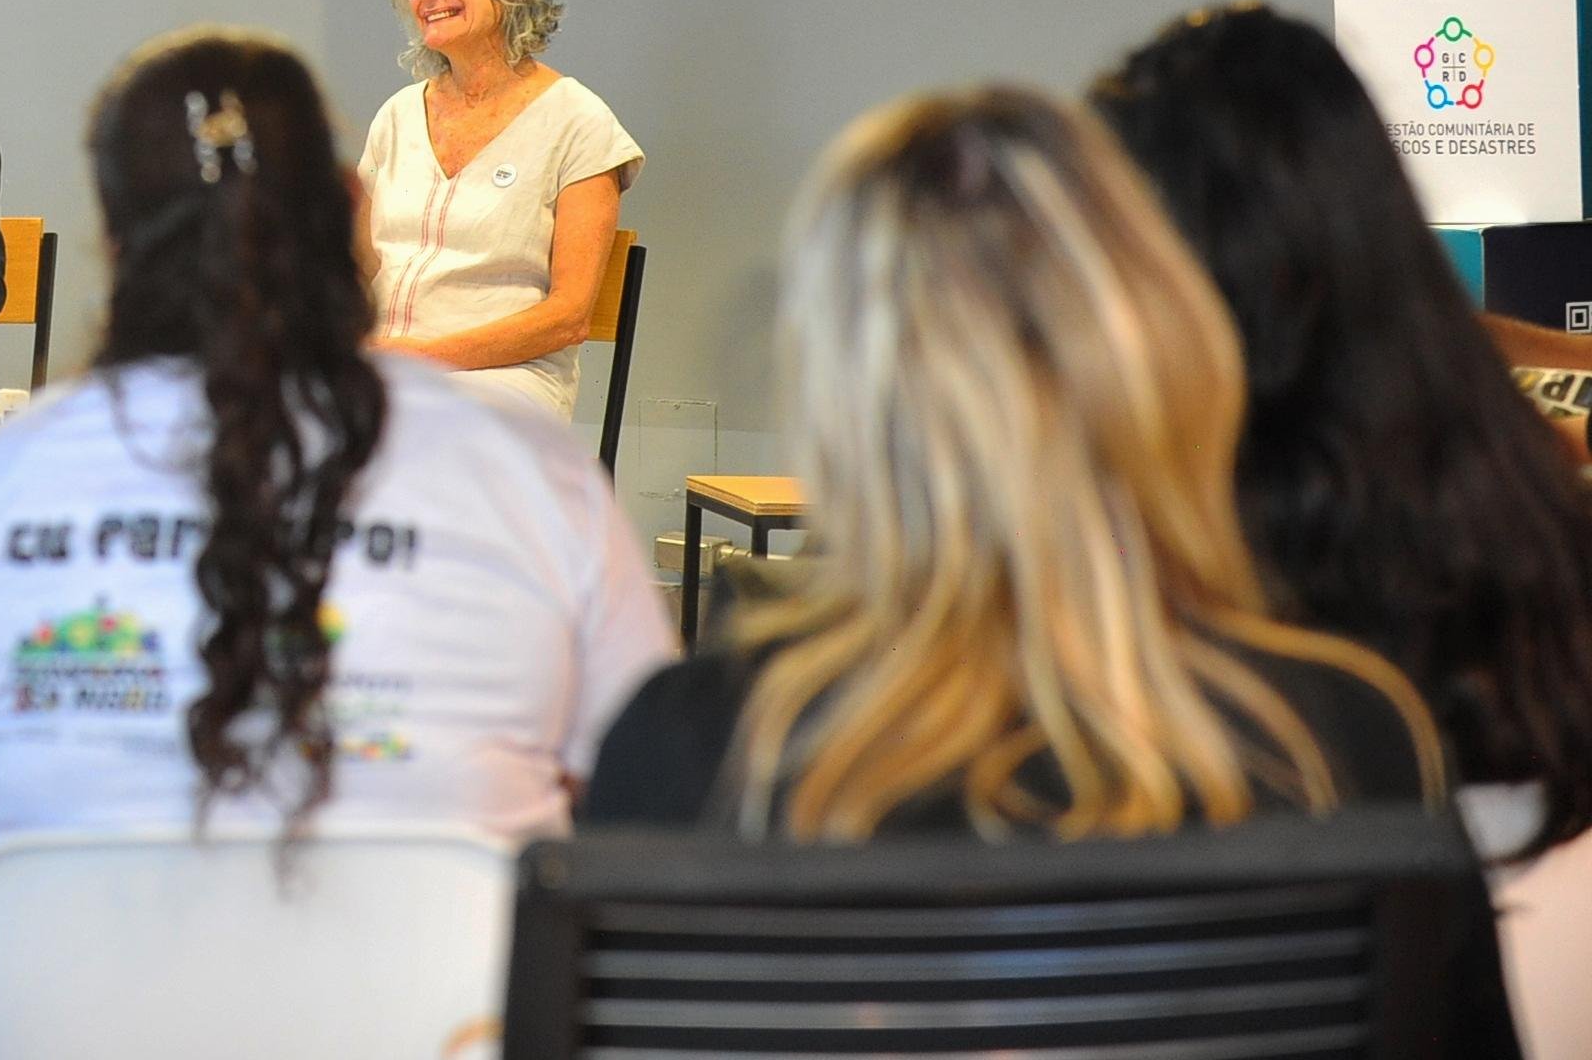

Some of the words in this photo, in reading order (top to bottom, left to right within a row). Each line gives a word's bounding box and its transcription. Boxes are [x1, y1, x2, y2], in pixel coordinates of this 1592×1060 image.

[1442, 52, 1450, 63] G
[1458, 52, 1466, 63] C
[1442, 71, 1450, 82] R
[1459, 71, 1466, 82] D
[1385, 120, 1425, 136] ESTÃO
[1428, 120, 1514, 136] COMUNITÁRIA
[1518, 123, 1535, 136] DE
[1392, 139, 1430, 154] SCOS
[1435, 139, 1444, 154] E
[1448, 139, 1536, 154] DESASTRES
